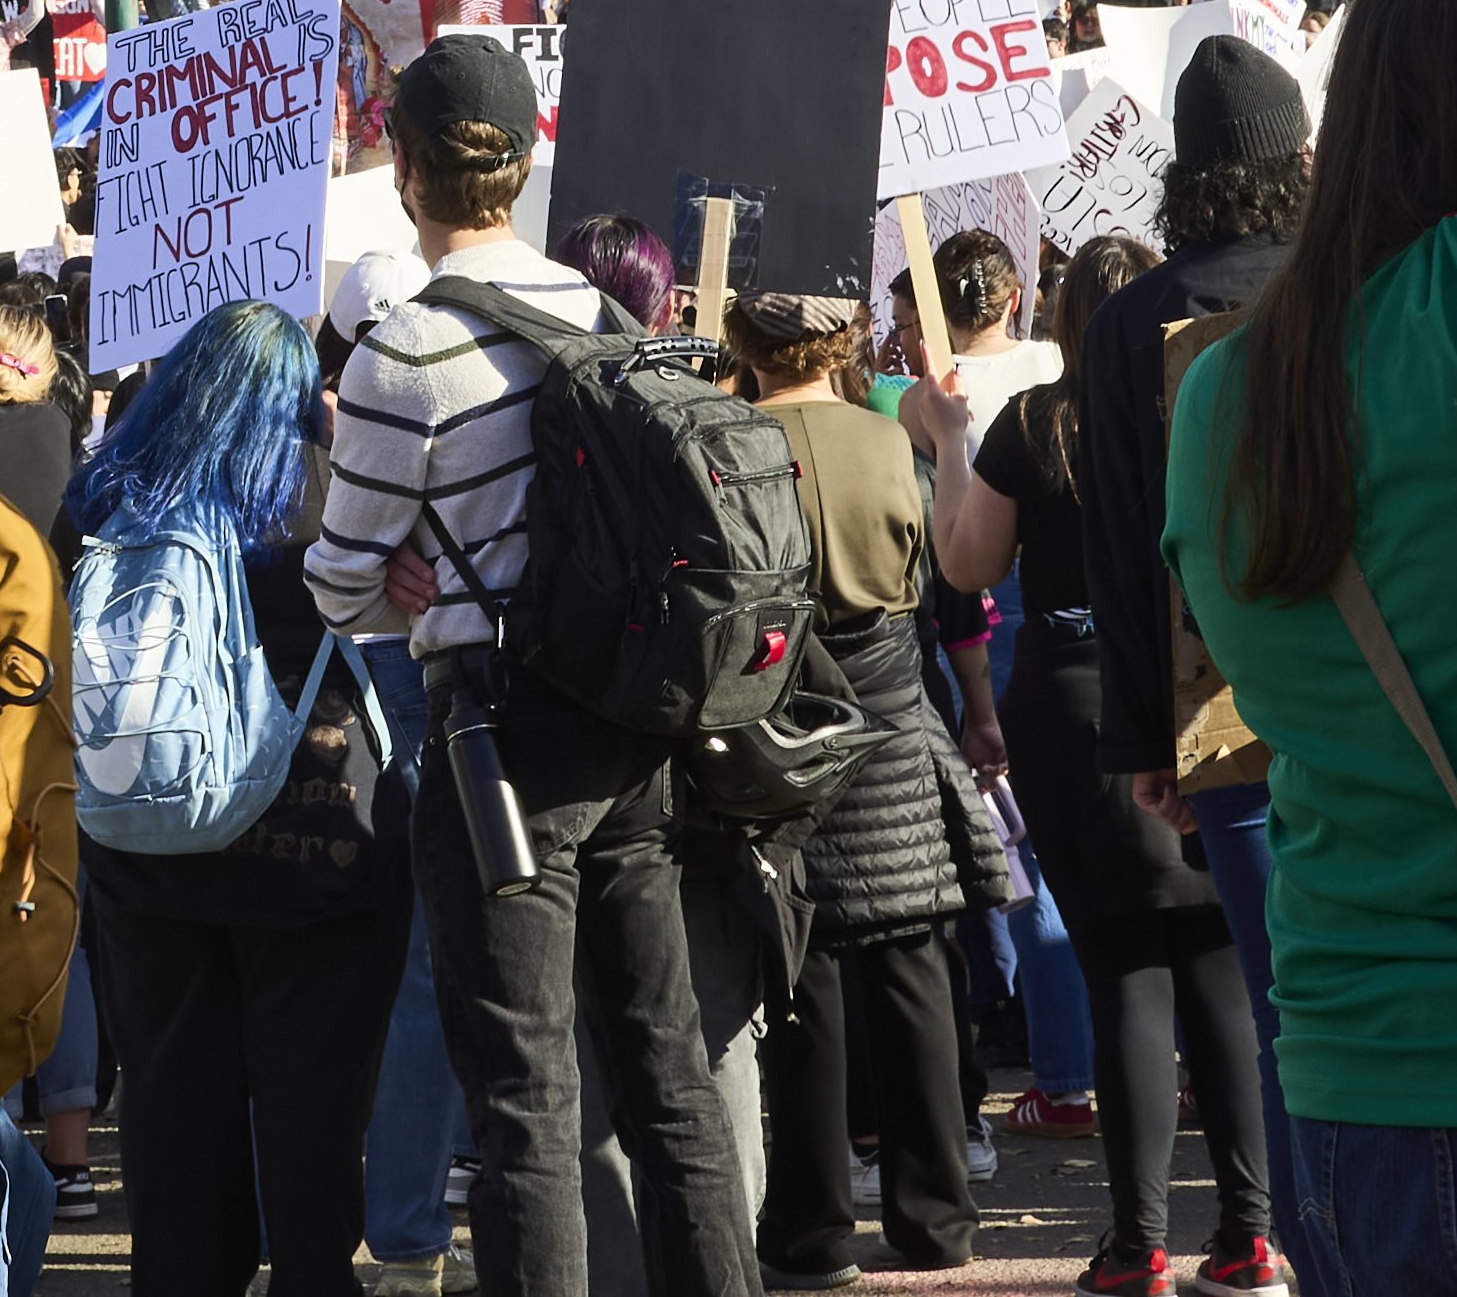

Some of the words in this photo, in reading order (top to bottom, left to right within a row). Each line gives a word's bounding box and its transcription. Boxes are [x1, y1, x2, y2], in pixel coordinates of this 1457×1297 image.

[106, 34, 287, 126] CRIMINAL
[115, 19, 196, 72] THE
[298, 13, 334, 67] IS
[107, 122, 140, 170] IN
[171, 61, 324, 154] OFFICE!
[895, 79, 1062, 164] RULERS
[95, 160, 169, 238] FIGHT
[187, 110, 325, 209] IGNORANCE
[152, 195, 245, 270] NOT
[97, 224, 313, 346] IMMIGRANTS!
